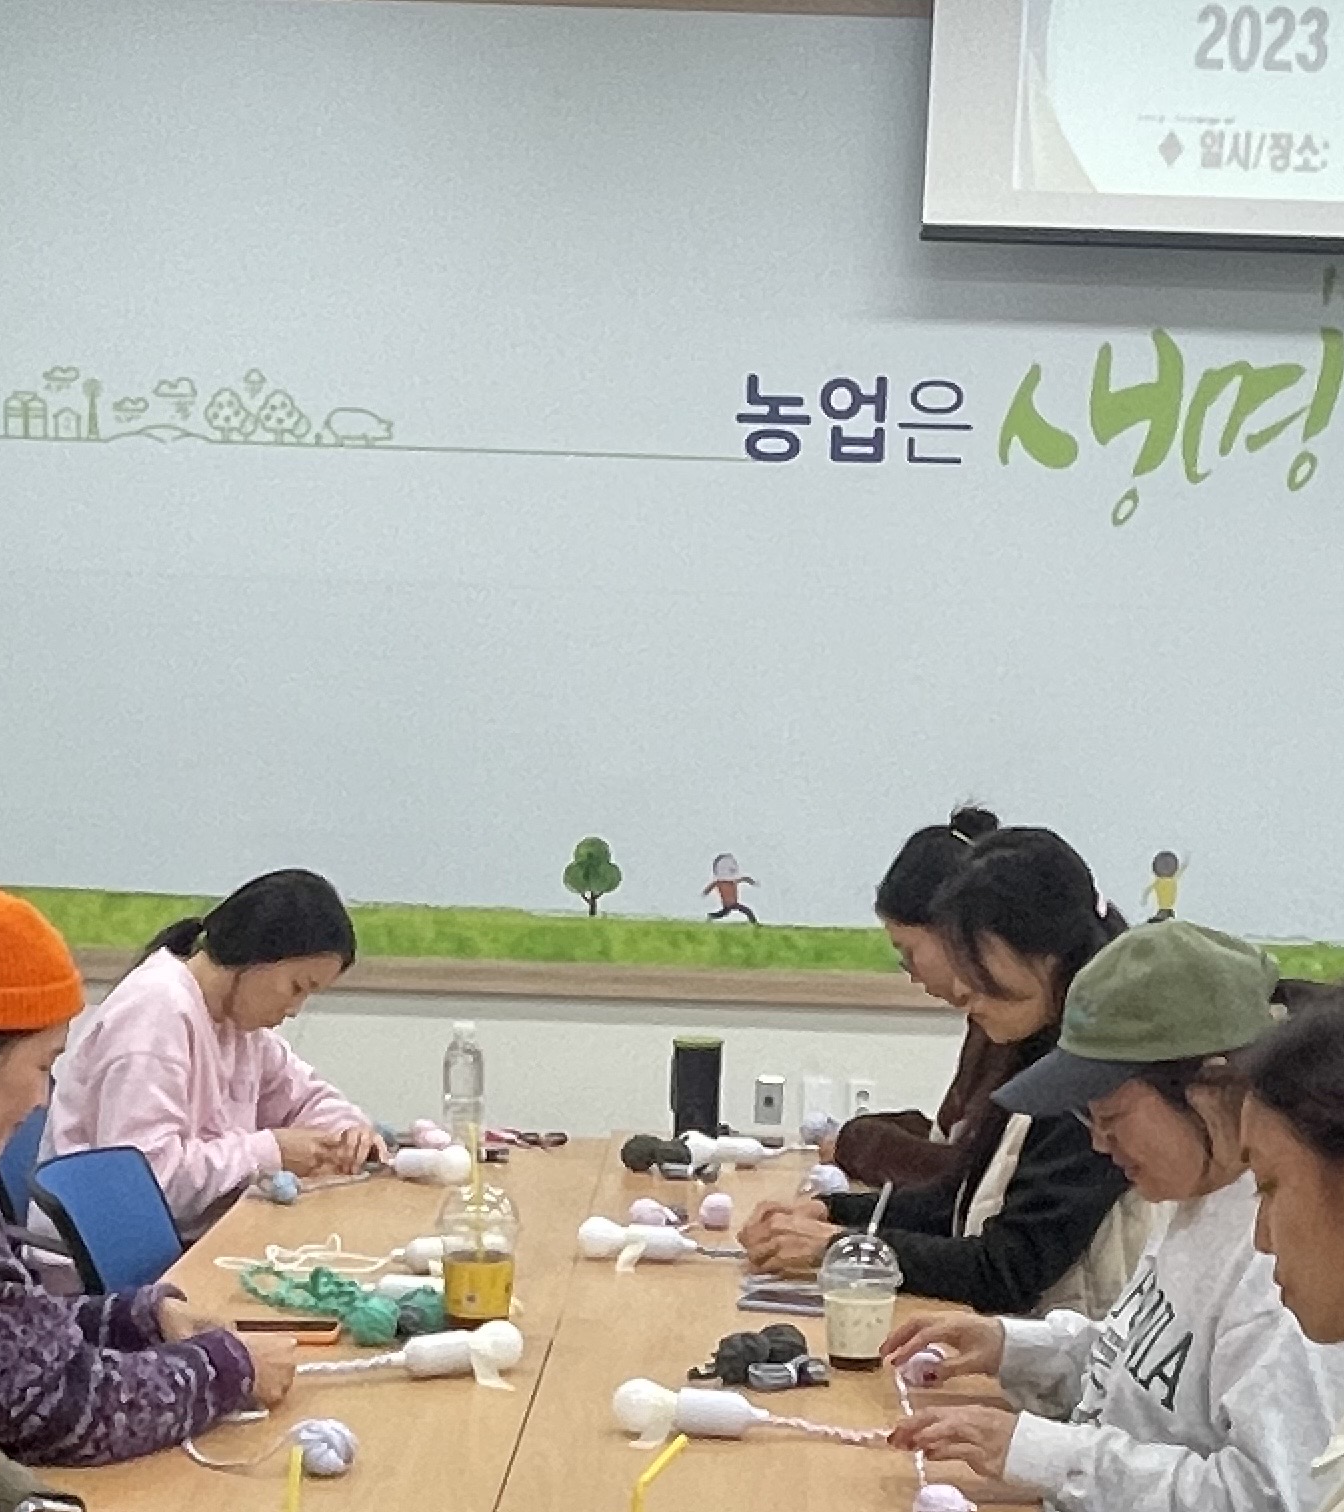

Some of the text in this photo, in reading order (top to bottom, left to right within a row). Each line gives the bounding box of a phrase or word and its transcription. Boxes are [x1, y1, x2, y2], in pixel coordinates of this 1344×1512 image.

[1194, 2, 1330, 74] 2023
[1199, 129, 1331, 174] 일시/장소:
[735, 372, 974, 465] 농업은
